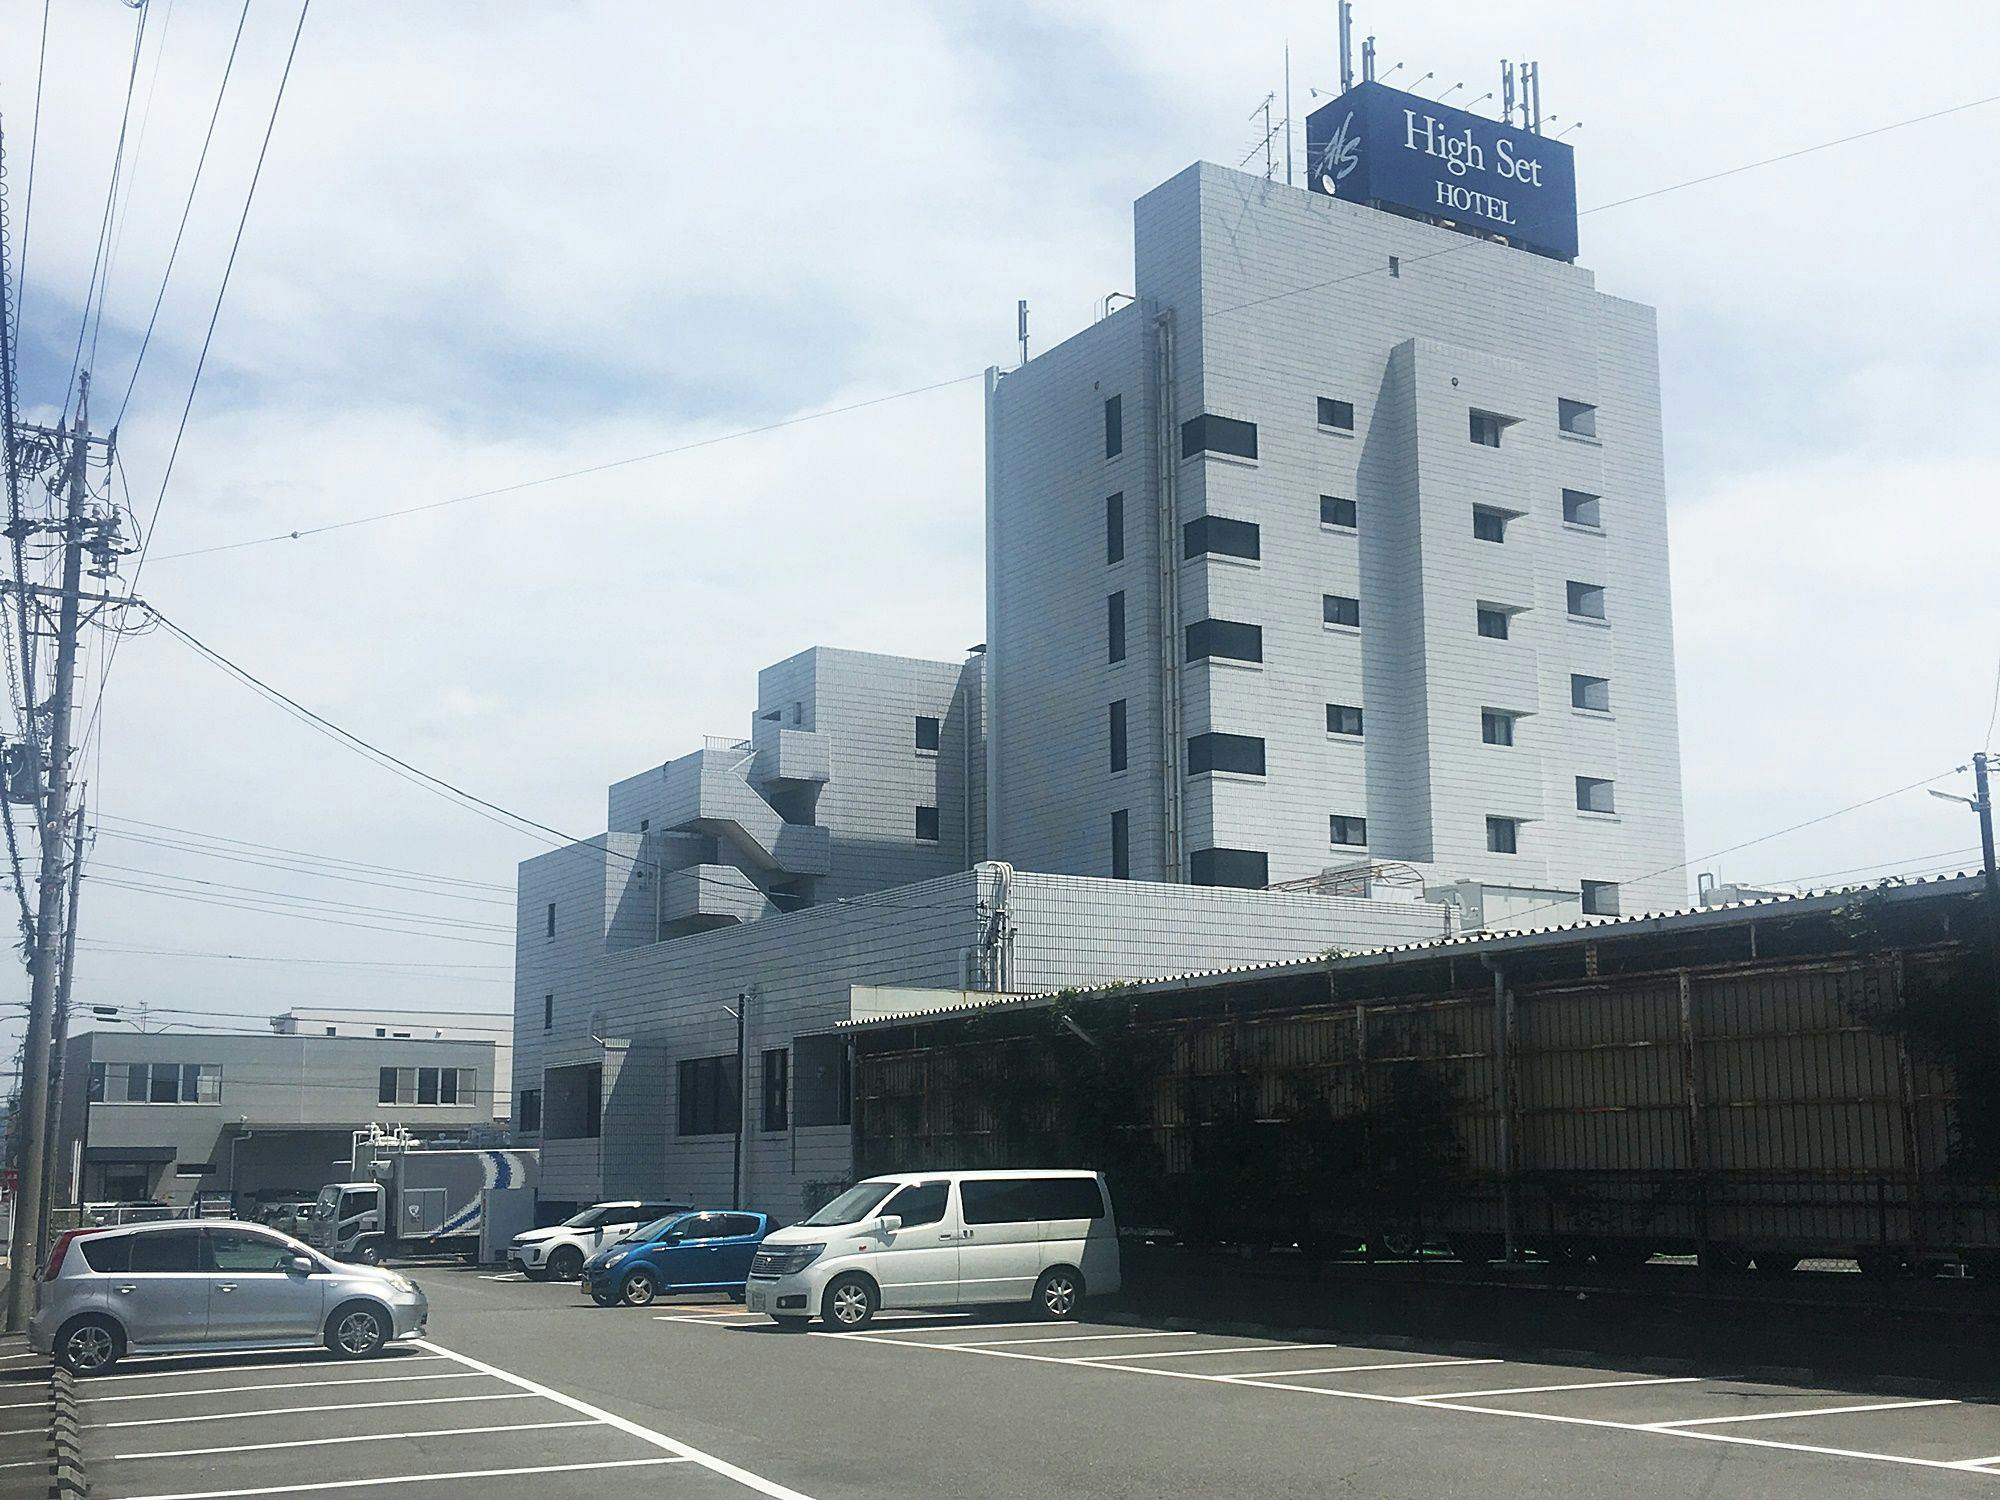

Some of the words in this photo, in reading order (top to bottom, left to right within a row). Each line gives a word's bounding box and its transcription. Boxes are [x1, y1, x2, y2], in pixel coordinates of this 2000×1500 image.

[1404, 109, 1486, 176] High
[1496, 138, 1543, 187] Set
[1435, 180, 1516, 225] HOTEL
